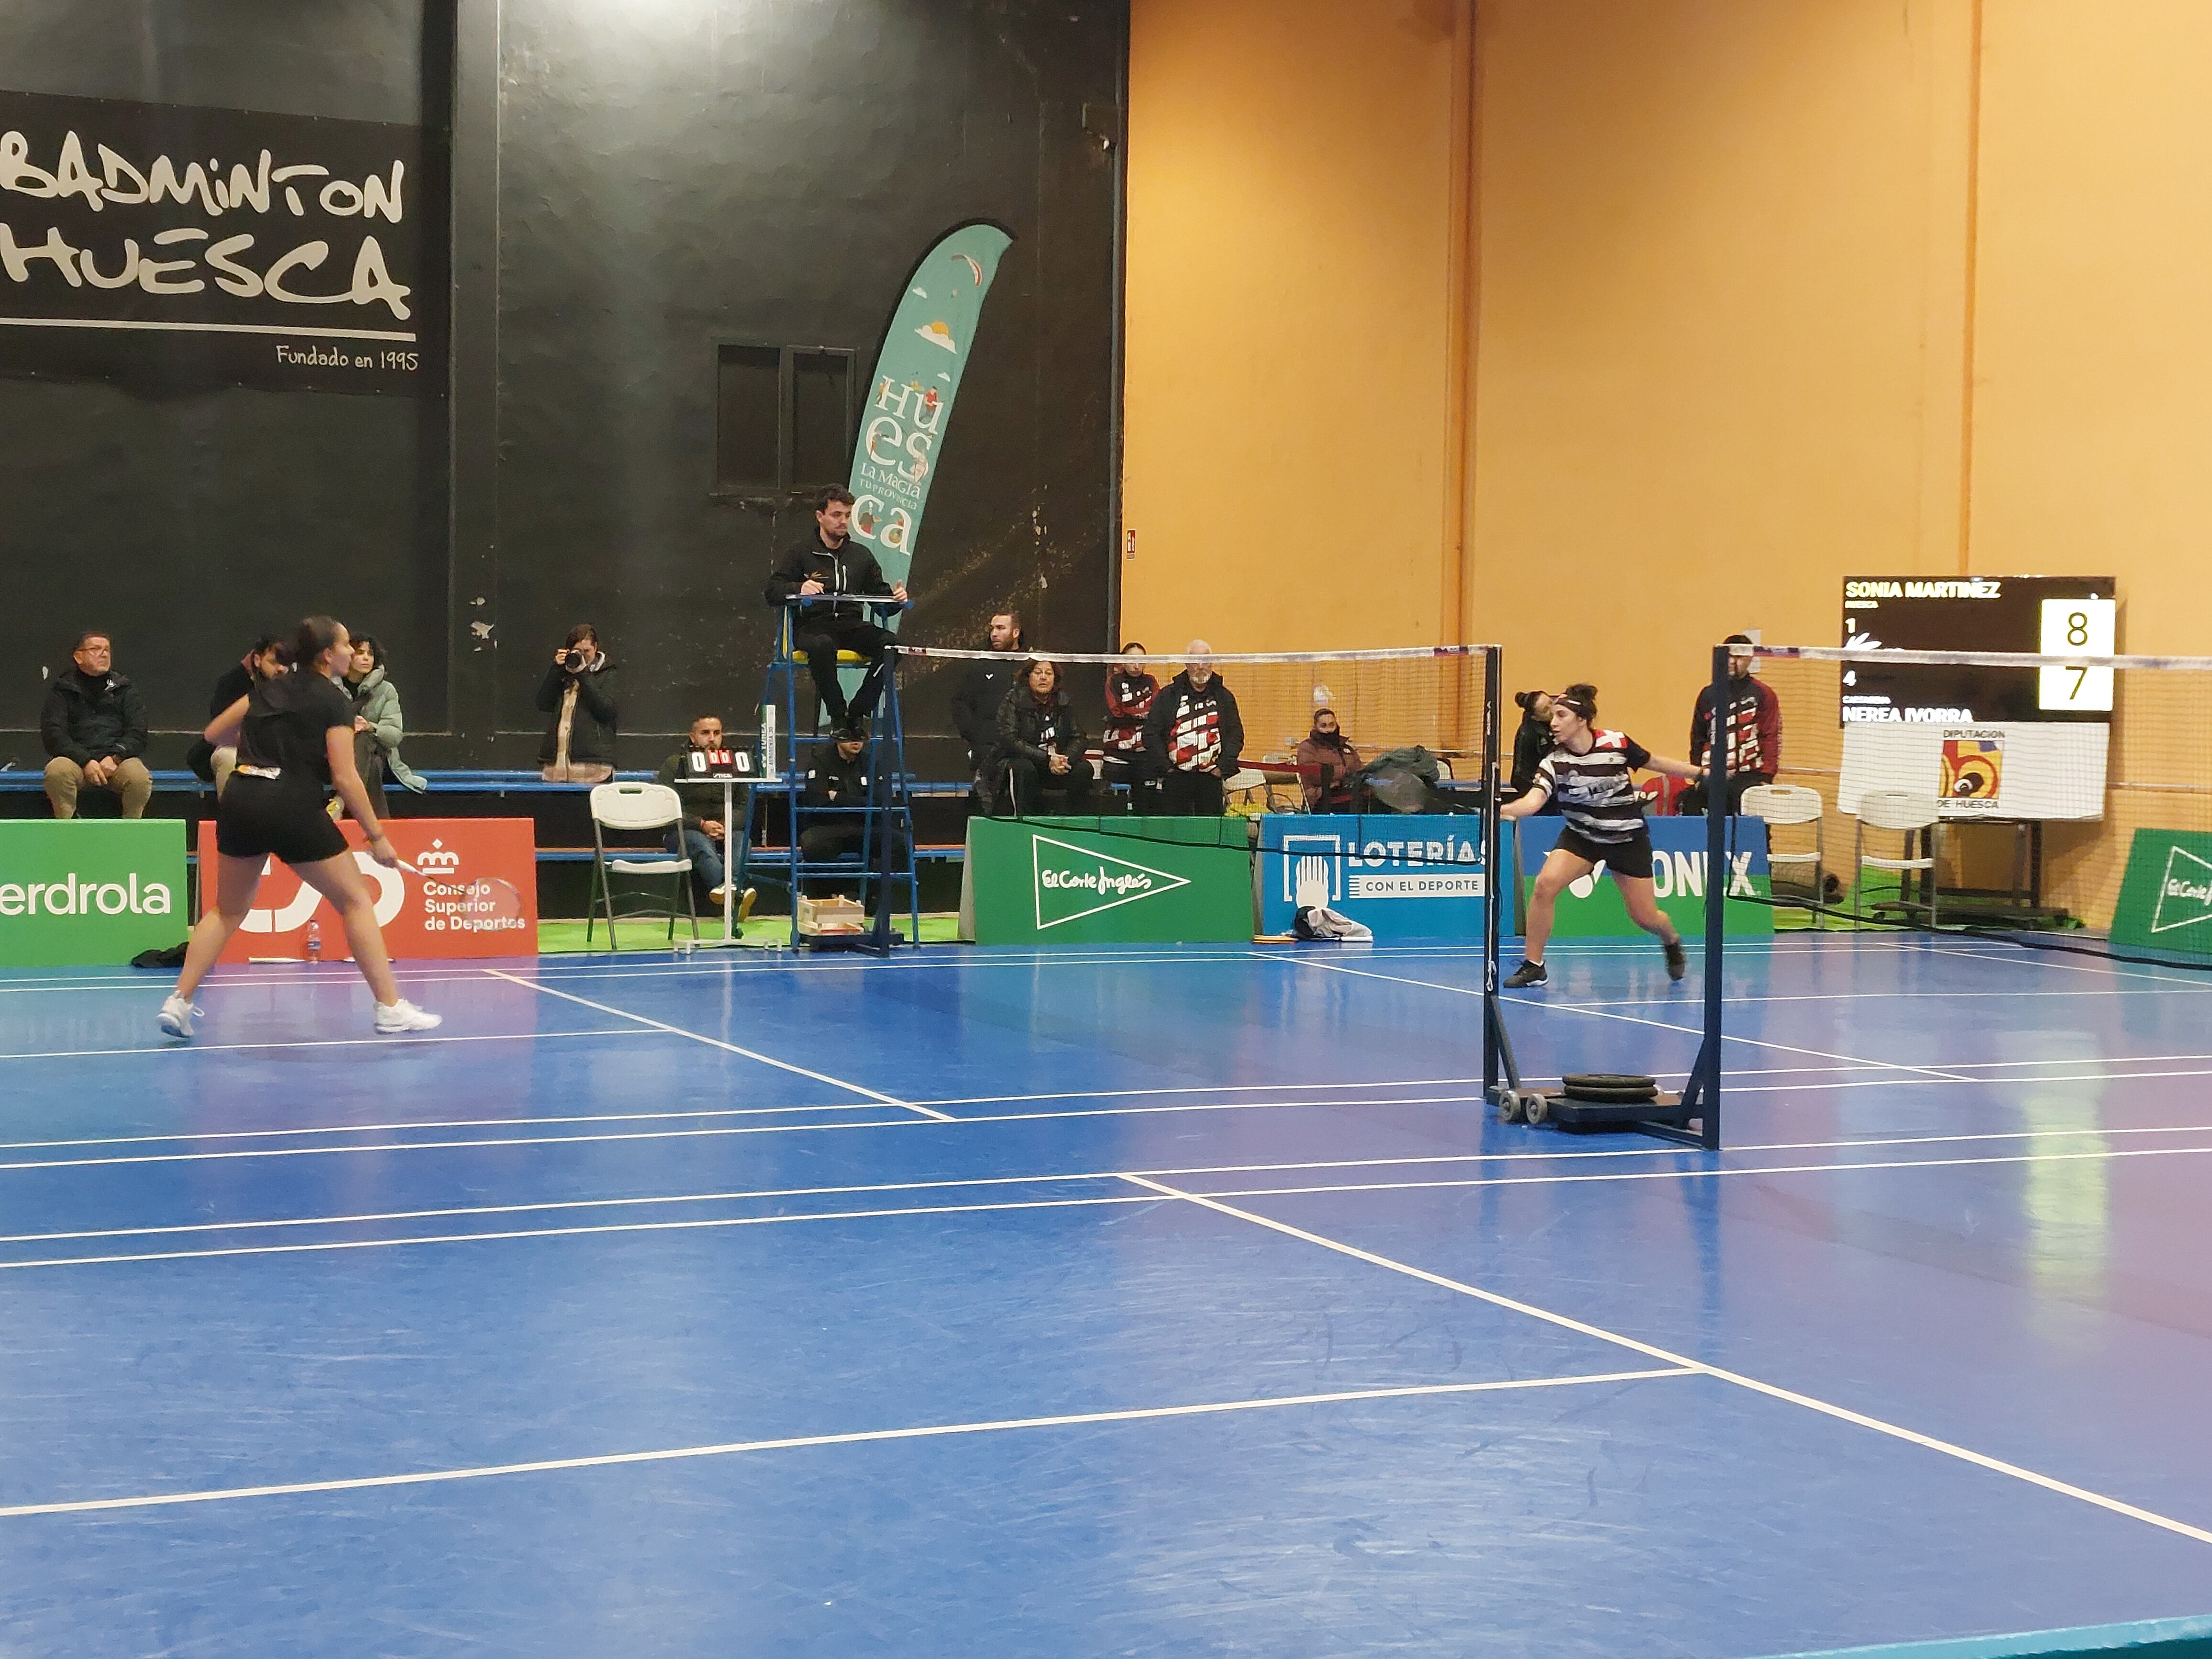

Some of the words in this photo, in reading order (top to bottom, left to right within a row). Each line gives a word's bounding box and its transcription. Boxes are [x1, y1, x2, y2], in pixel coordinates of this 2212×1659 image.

[0, 222, 411, 321] HUESCA
[276, 345, 349, 366] Fundado
[354, 356, 373, 368] en
[381, 351, 419, 371] 1995
[1845, 581, 1903, 598] SONIA
[1905, 581, 2001, 598] MARTINEZ
[1845, 618, 1856, 634] 1
[2067, 612, 2088, 646] 8
[1842, 670, 1857, 686] 4
[2065, 666, 2088, 700] 7
[1842, 706, 1902, 722] NEREA
[1904, 707, 1974, 723] IVORRA
[692, 752, 707, 772] 0
[710, 752, 718, 763] 0
[721, 752, 729, 763] 0
[735, 752, 750, 772] 0
[1937, 799, 1950, 808] DE
[1956, 800, 1999, 808] HUESCA
[423, 880, 491, 897] Consejo
[1041, 869, 1059, 888] El
[1059, 870, 1097, 888] Corte
[1098, 865, 1152, 895] Inglés
[1366, 881, 1394, 892] CON
[1400, 881, 1413, 891] EL
[1419, 880, 1479, 891] DEPORTE
[0, 874, 171, 915] erdrola
[425, 898, 496, 916] Superior
[425, 916, 446, 930] de
[450, 916, 526, 933] Deportes
